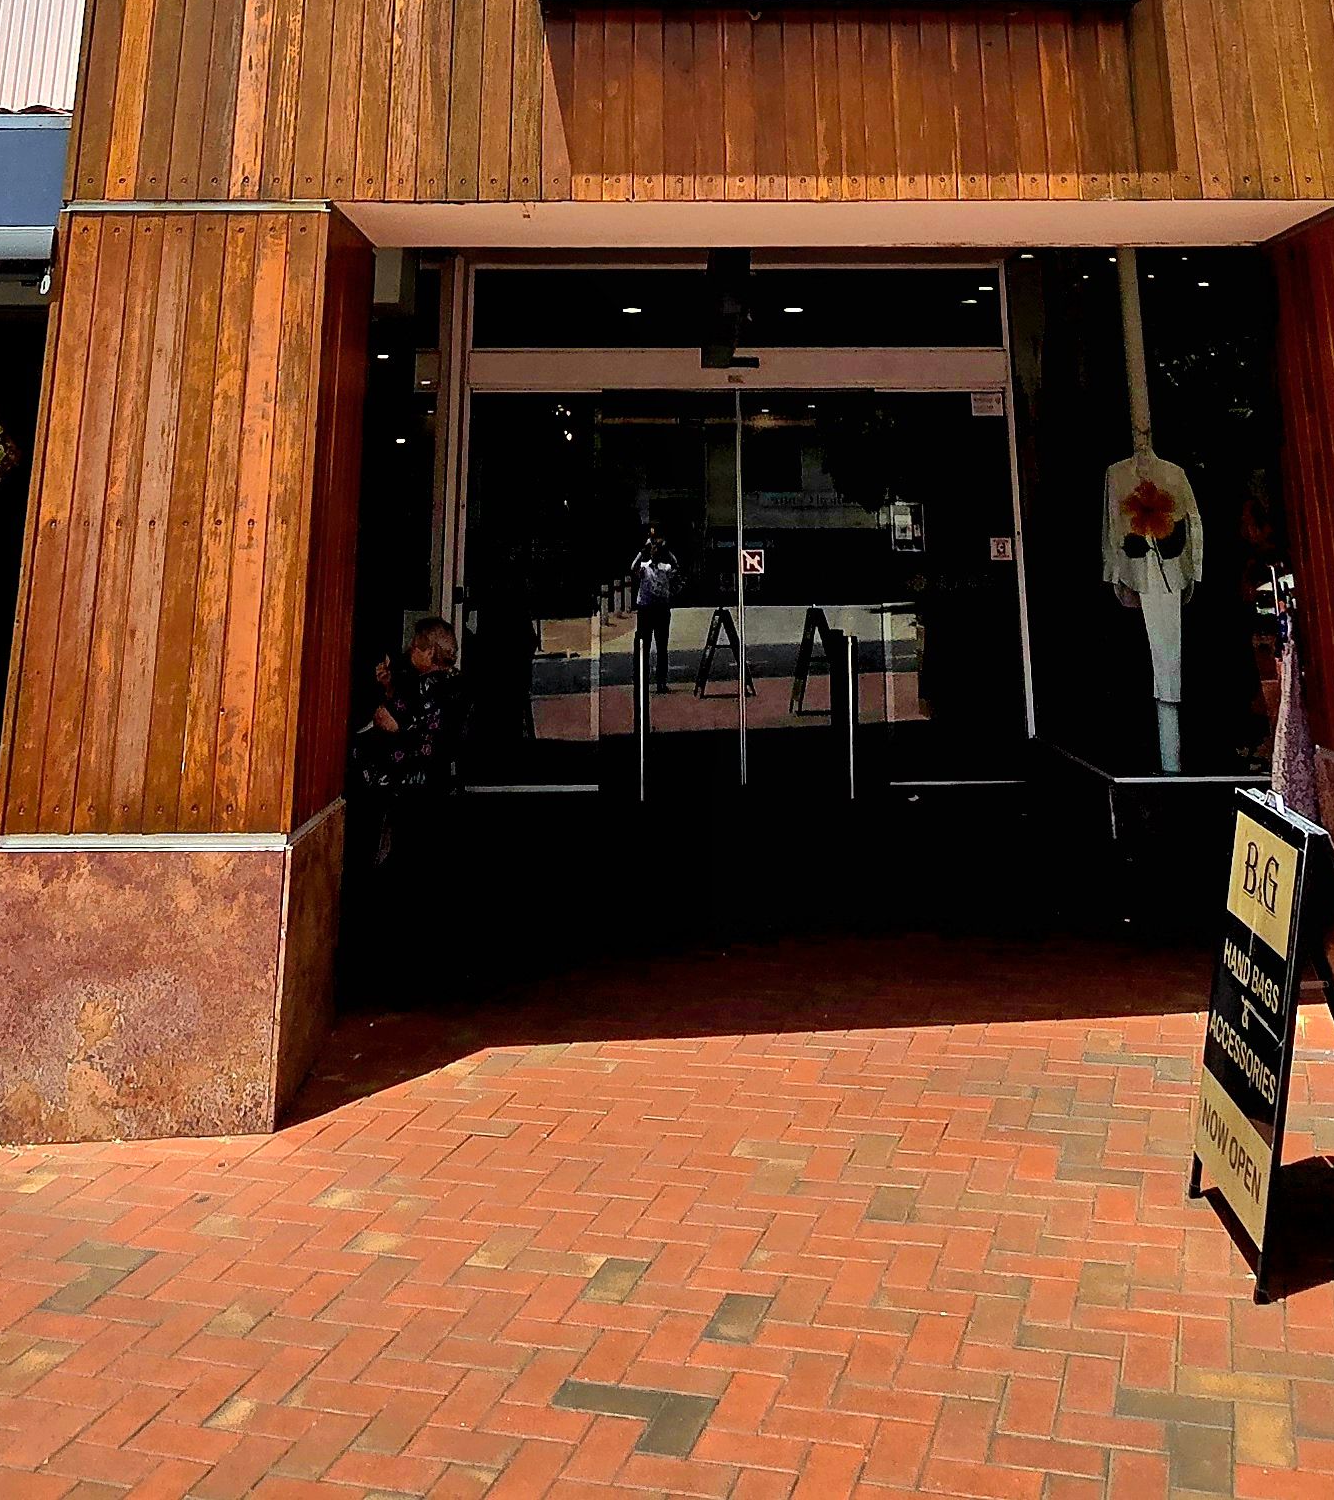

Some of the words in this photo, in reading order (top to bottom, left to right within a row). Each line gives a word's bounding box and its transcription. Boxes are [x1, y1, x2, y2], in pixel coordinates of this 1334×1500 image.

[1223, 938, 1251, 983] HAND
[1251, 965, 1280, 1014] BAGS
[1209, 1009, 1276, 1105] ACCESSORIES
[1202, 1098, 1229, 1155] NOW
[1229, 1136, 1261, 1204] OPEN
